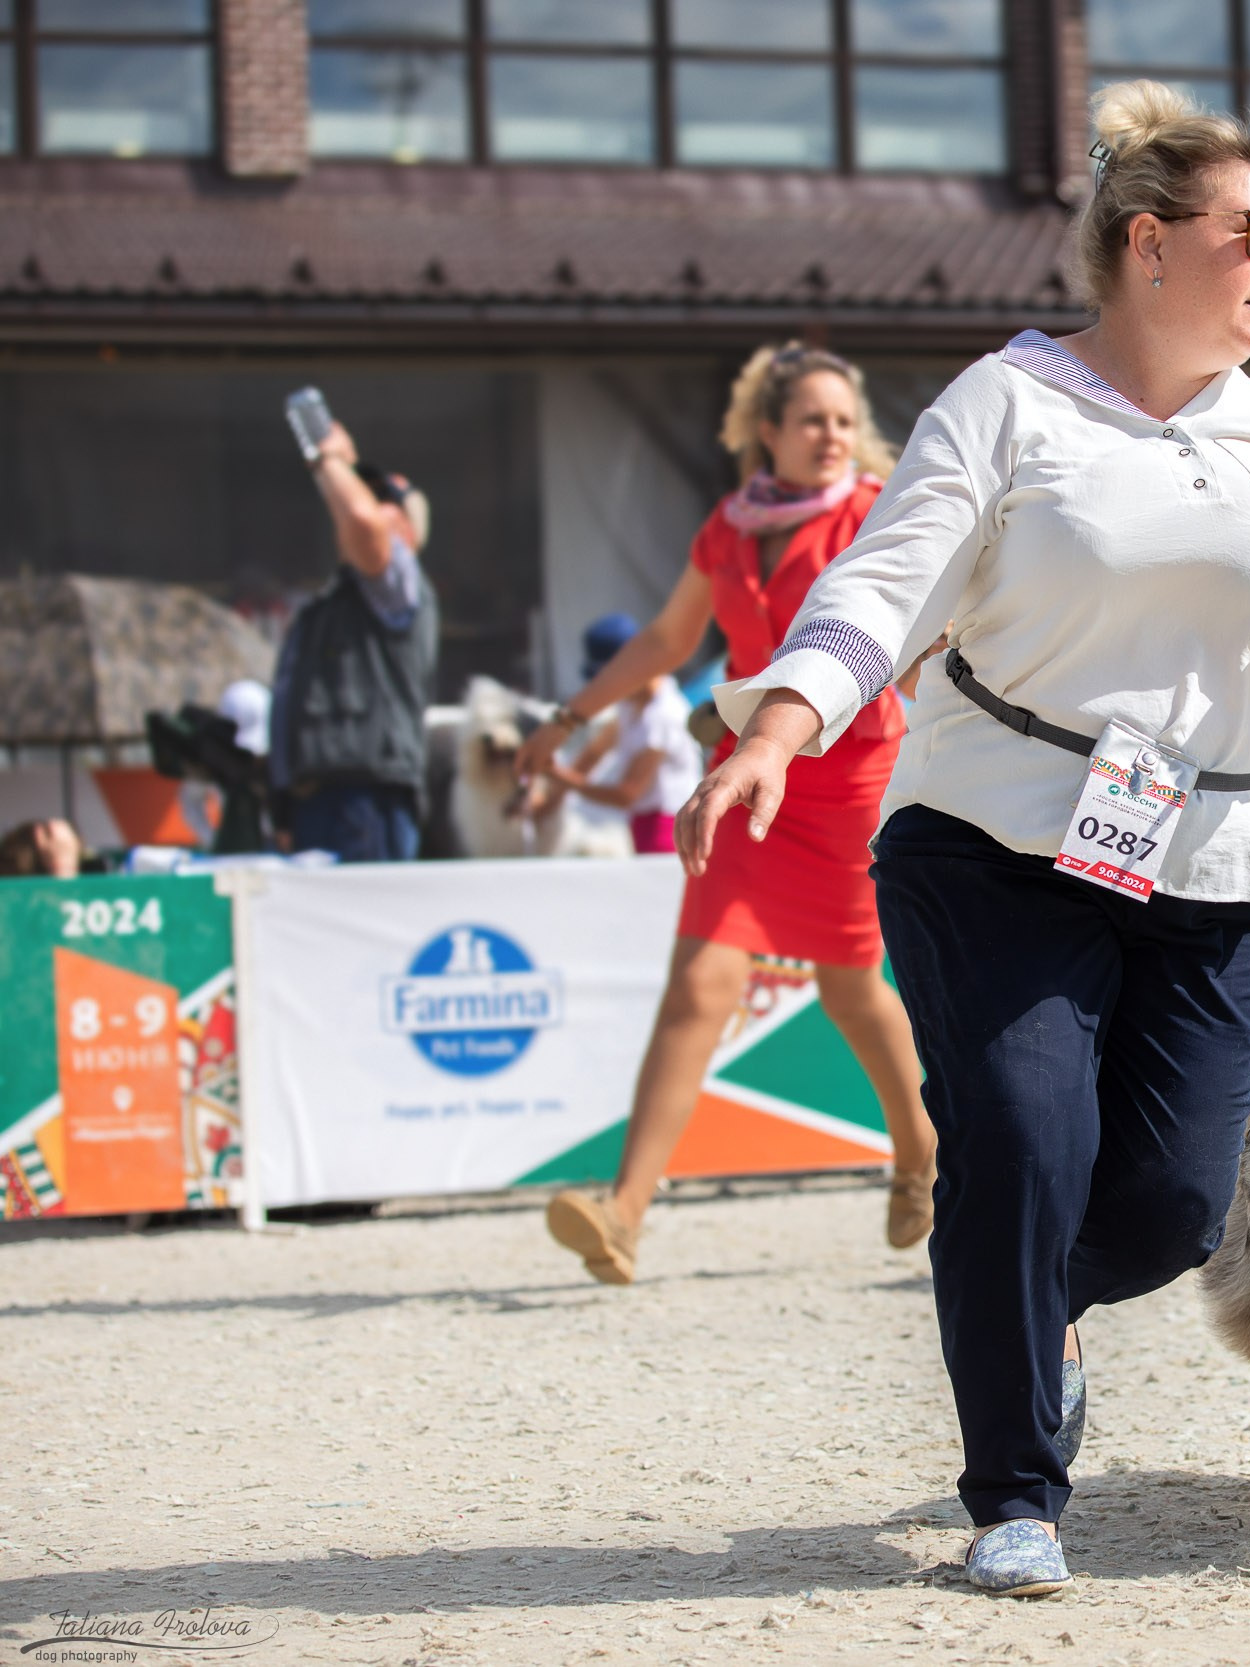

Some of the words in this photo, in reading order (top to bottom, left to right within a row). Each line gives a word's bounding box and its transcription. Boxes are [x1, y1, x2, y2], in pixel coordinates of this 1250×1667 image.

[1122, 791, 1158, 810] РОССИЯ
[1078, 816, 1158, 862] 0287
[1098, 866, 1146, 890] 9.06.2024
[61, 898, 163, 937] 2024
[394, 978, 550, 1023] Farmina
